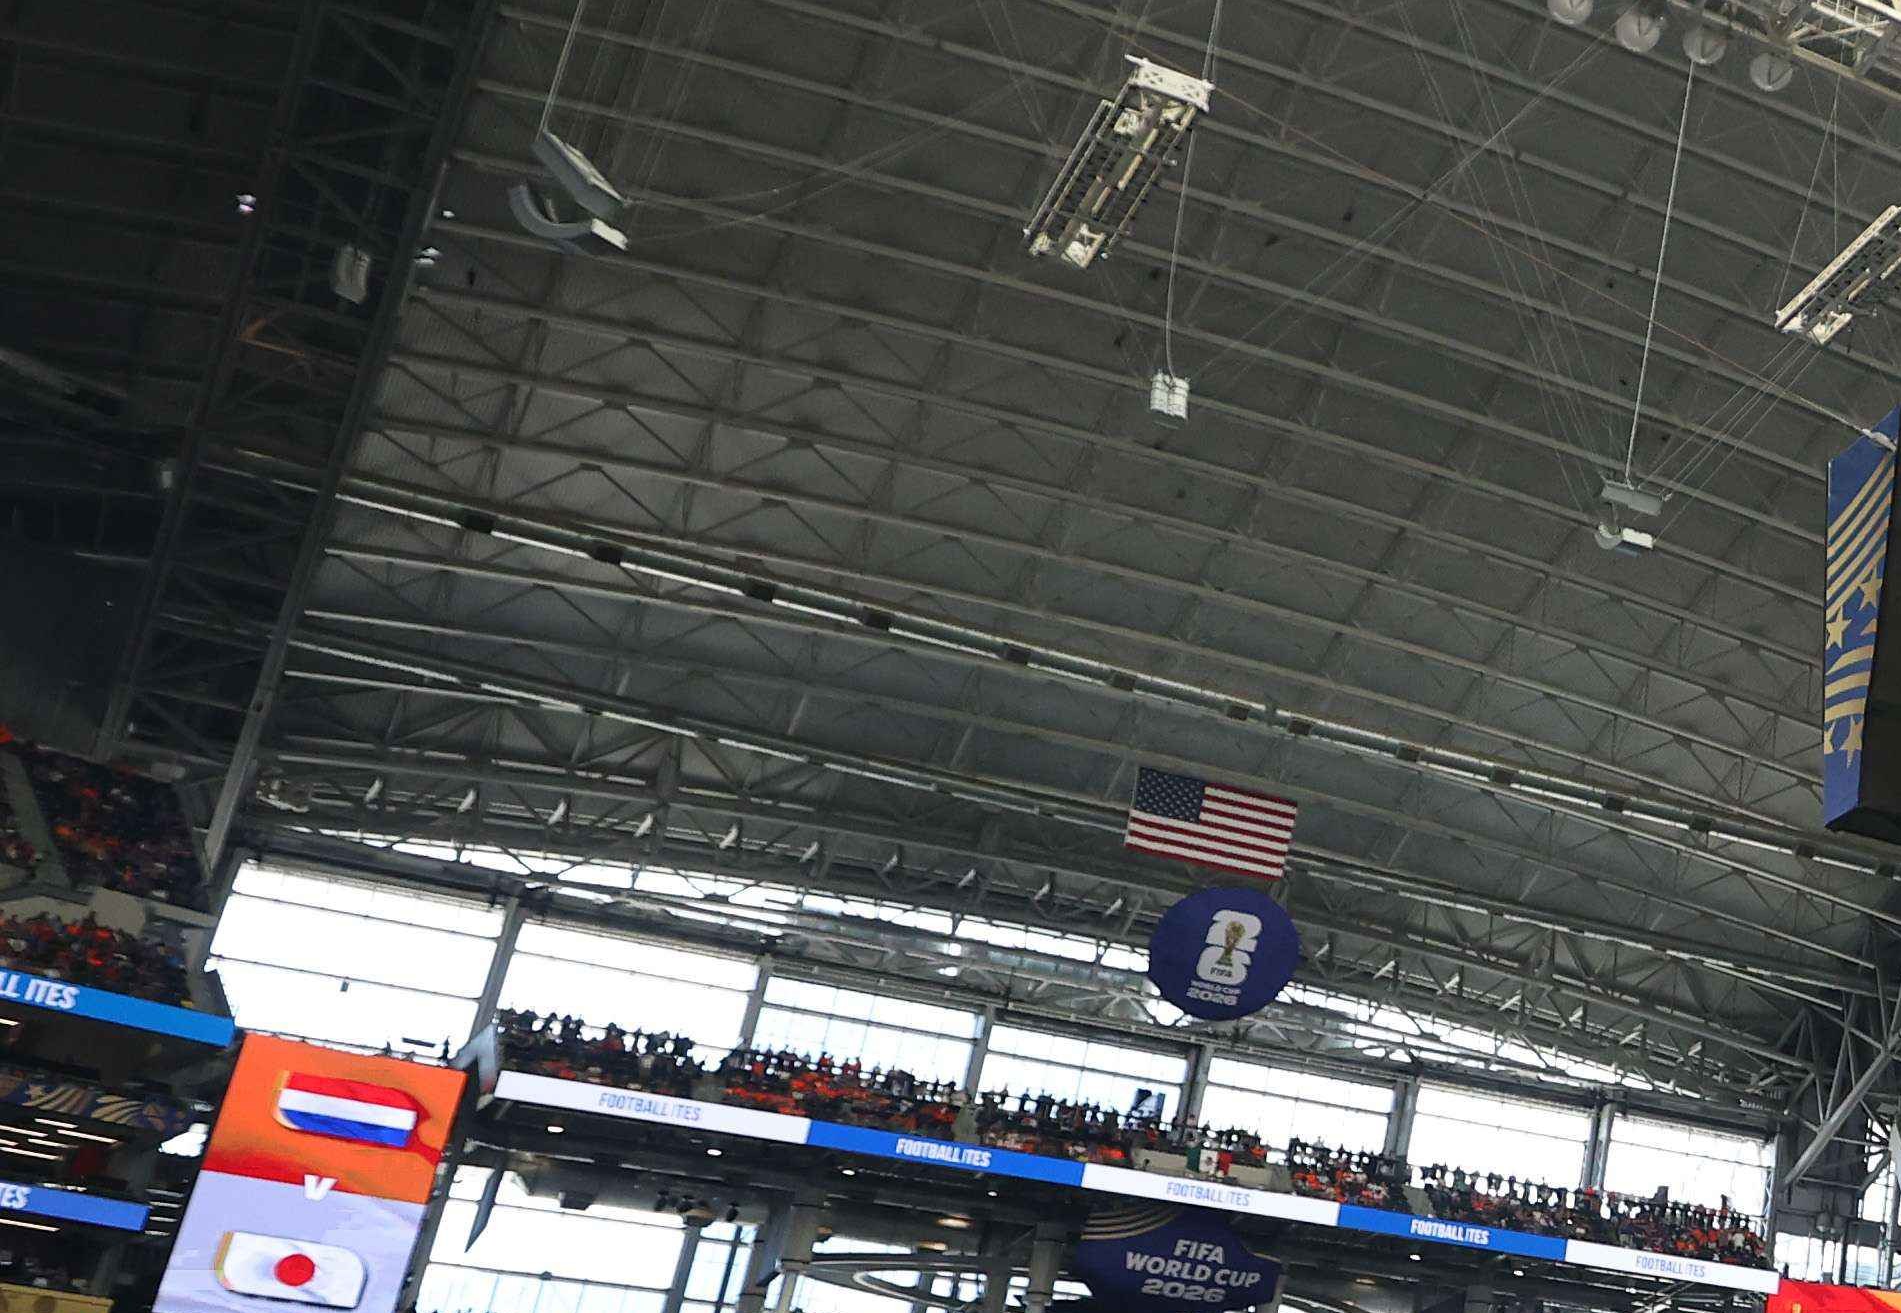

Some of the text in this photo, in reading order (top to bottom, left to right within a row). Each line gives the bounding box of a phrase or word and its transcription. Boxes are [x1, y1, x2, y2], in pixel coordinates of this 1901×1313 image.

[598, 1092, 670, 1119] FOOTBALL
[895, 1138, 961, 1163] FOOTBALL
[1166, 1181, 1222, 1204] FOOTBALL
[1410, 1217, 1461, 1241] FOOTBALL
[1173, 1239, 1225, 1265] FIFA
[1125, 1251, 1262, 1288] WORLD CUP
[1635, 1255, 1683, 1276] FOOTBALL
[1140, 1278, 1226, 1303] 2026
